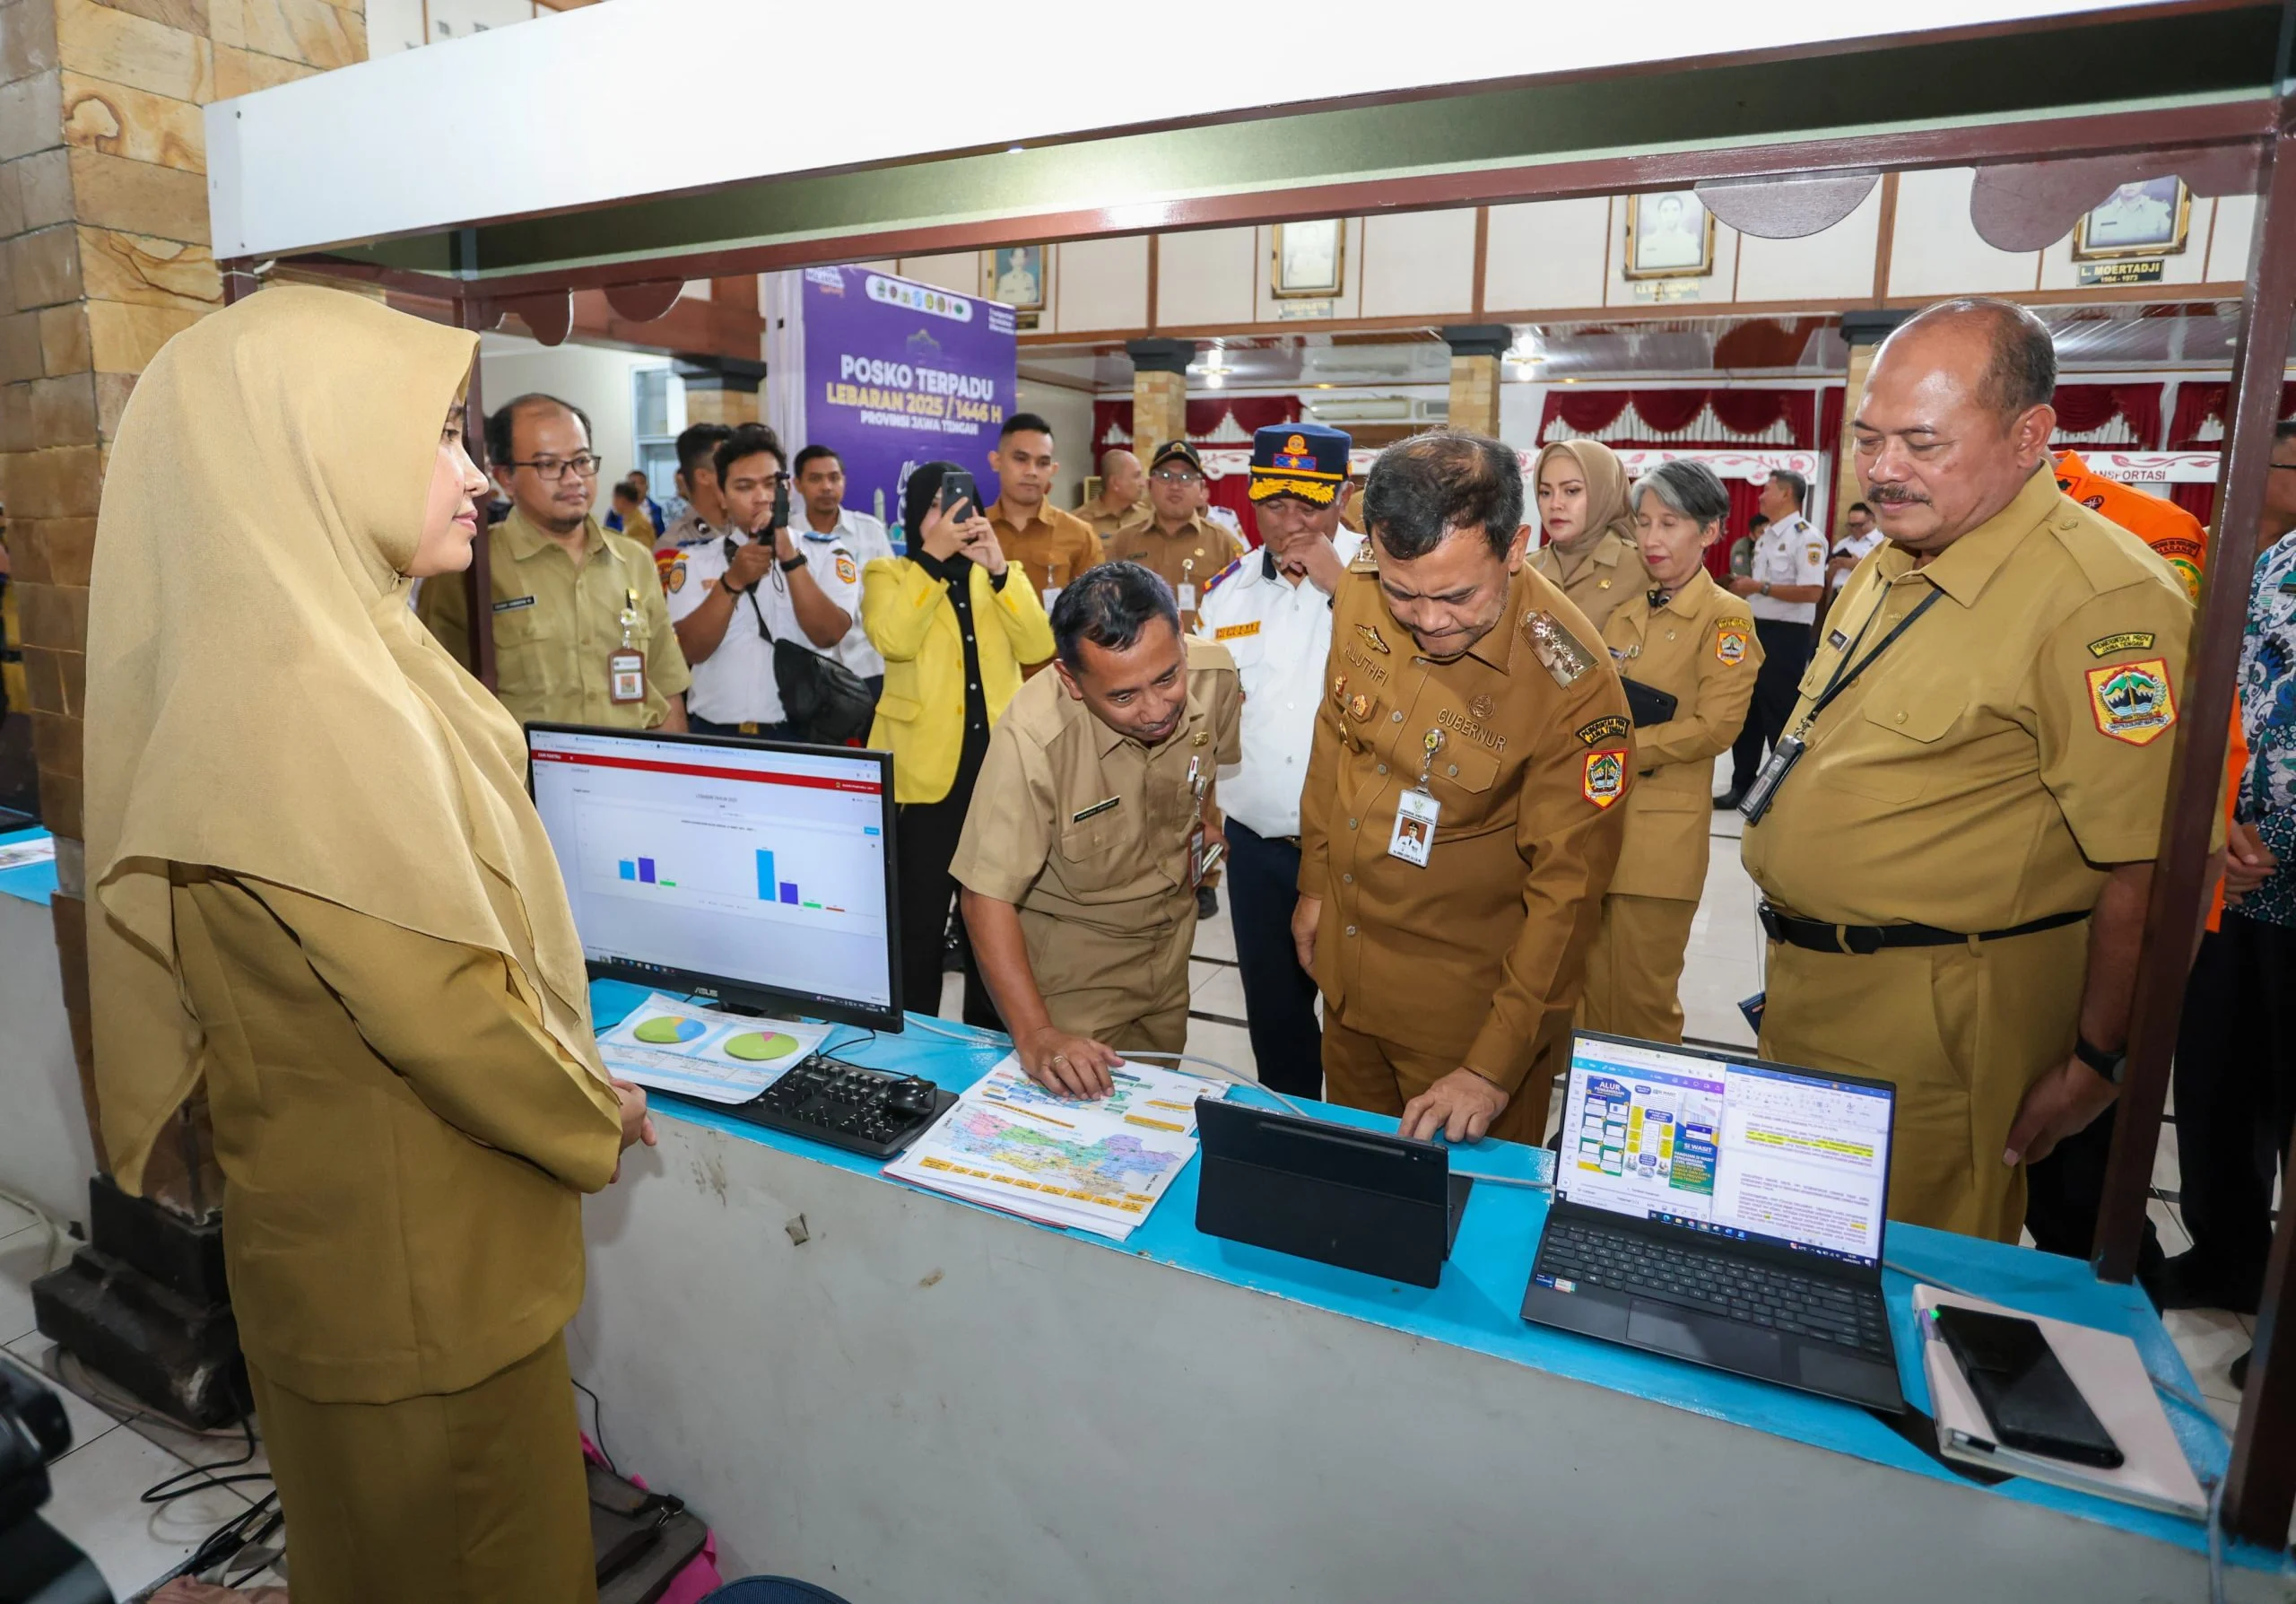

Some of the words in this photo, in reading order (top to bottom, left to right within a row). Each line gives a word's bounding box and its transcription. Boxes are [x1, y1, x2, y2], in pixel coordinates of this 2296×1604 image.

[2081, 267, 2091, 276] L.
[2094, 262, 2161, 276] MOERTADJI
[840, 354, 913, 390] POSKO
[915, 367, 995, 402] TERPADU
[826, 382, 905, 412] LEBARAN
[906, 393, 944, 417] 2025
[955, 400, 989, 423] 1446
[990, 405, 1003, 424] H
[860, 410, 910, 429] PROVINSI
[910, 415, 941, 432] JAWA
[942, 419, 980, 436] TENGAH
[2092, 469, 2166, 481] NSPORTASI
[1437, 707, 1508, 754] GUBERNUR
[694, 987, 718, 998] ASUS
[1599, 1082, 1621, 1091] ALUR
[1692, 1144, 1712, 1153] WASIT
